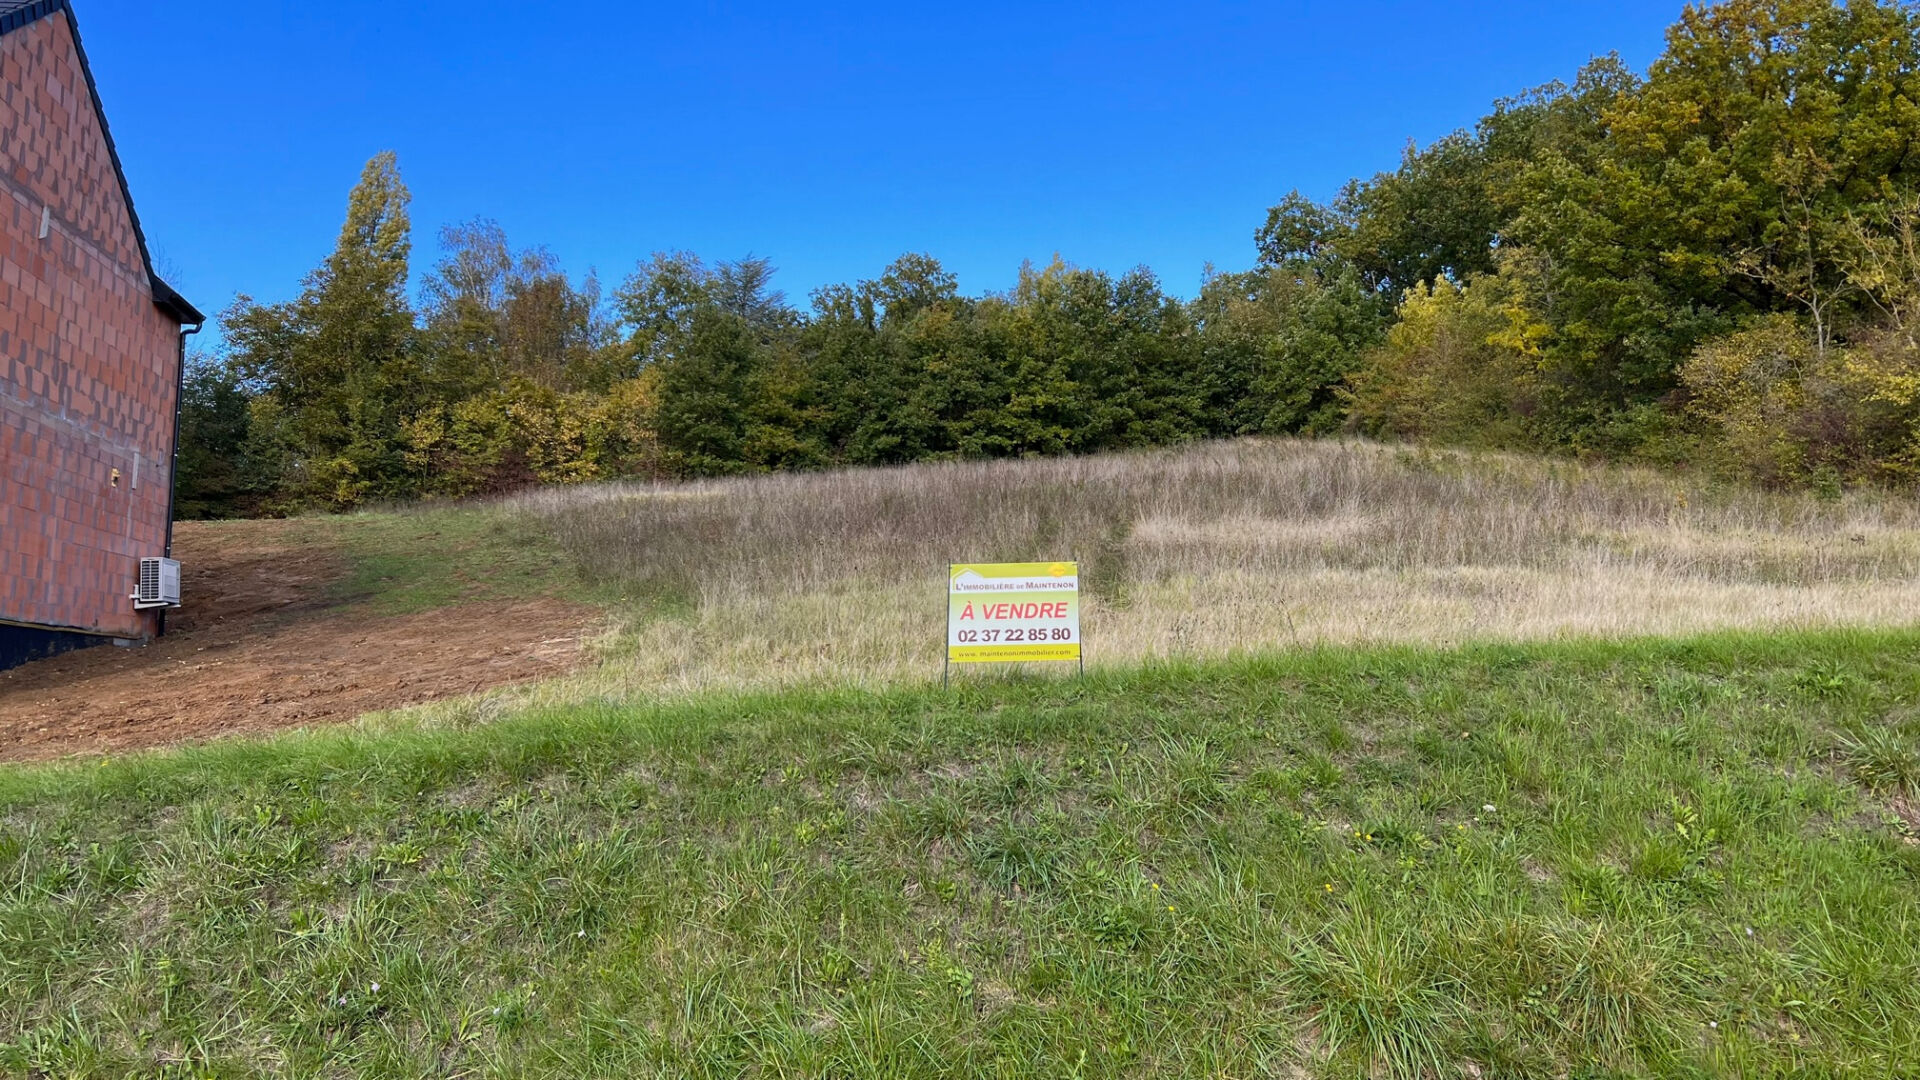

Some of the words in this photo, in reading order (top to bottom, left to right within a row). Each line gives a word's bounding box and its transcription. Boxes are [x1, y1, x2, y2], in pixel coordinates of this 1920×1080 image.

[1025, 582, 1074, 590] MAINTENON
[960, 600, 974, 620] À
[982, 602, 1068, 620] VENDRE
[958, 629, 977, 642] 02
[981, 629, 1000, 642] 37
[1005, 629, 1024, 641] 22
[1029, 628, 1047, 641] 85
[1051, 628, 1071, 640] 80
